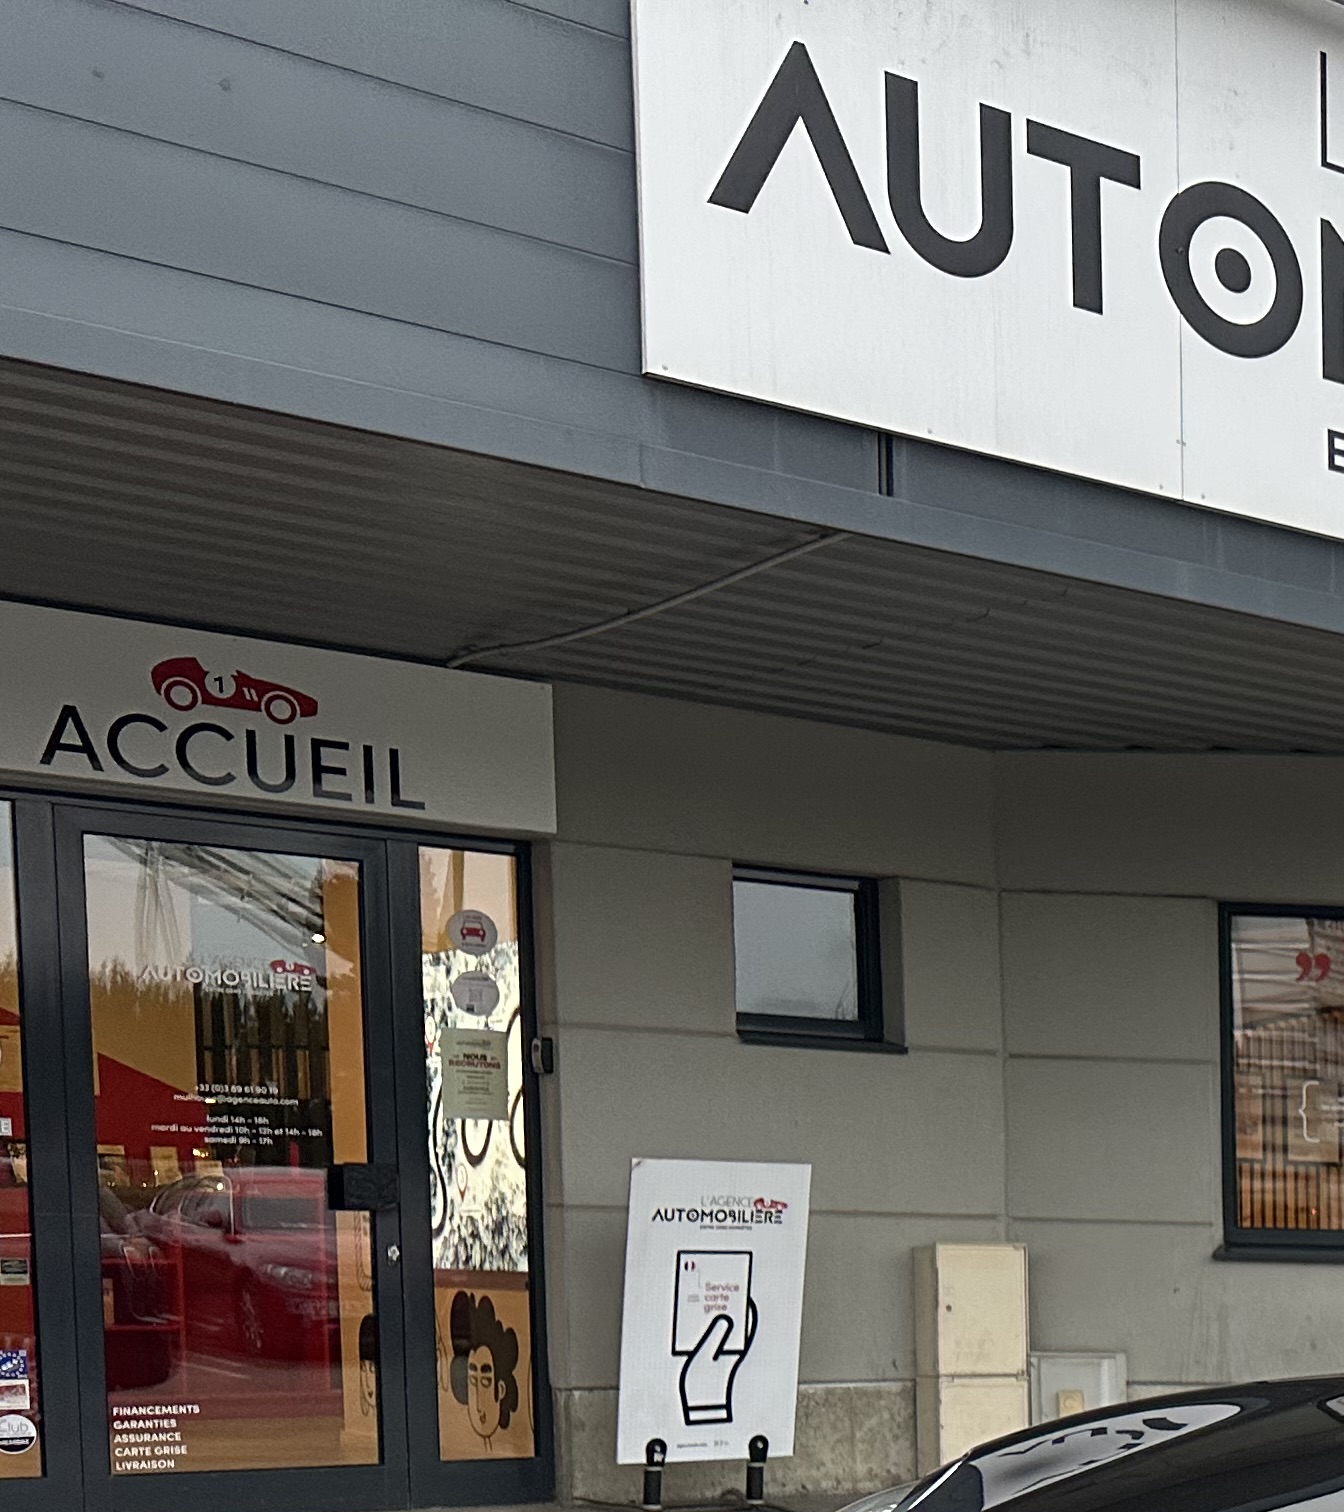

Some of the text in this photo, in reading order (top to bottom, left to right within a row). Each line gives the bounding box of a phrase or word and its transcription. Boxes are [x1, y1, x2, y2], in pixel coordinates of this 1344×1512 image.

[39, 703, 426, 811] ACCUEIL
[704, 1281, 740, 1292] Service
[112, 1404, 201, 1417] FINANCEMENTS
[112, 1418, 177, 1430] GARANTIES
[113, 1431, 182, 1444] ASSURANCE
[114, 1445, 188, 1457] CARTE GRISE
[115, 1459, 176, 1471] LIVRAISON
